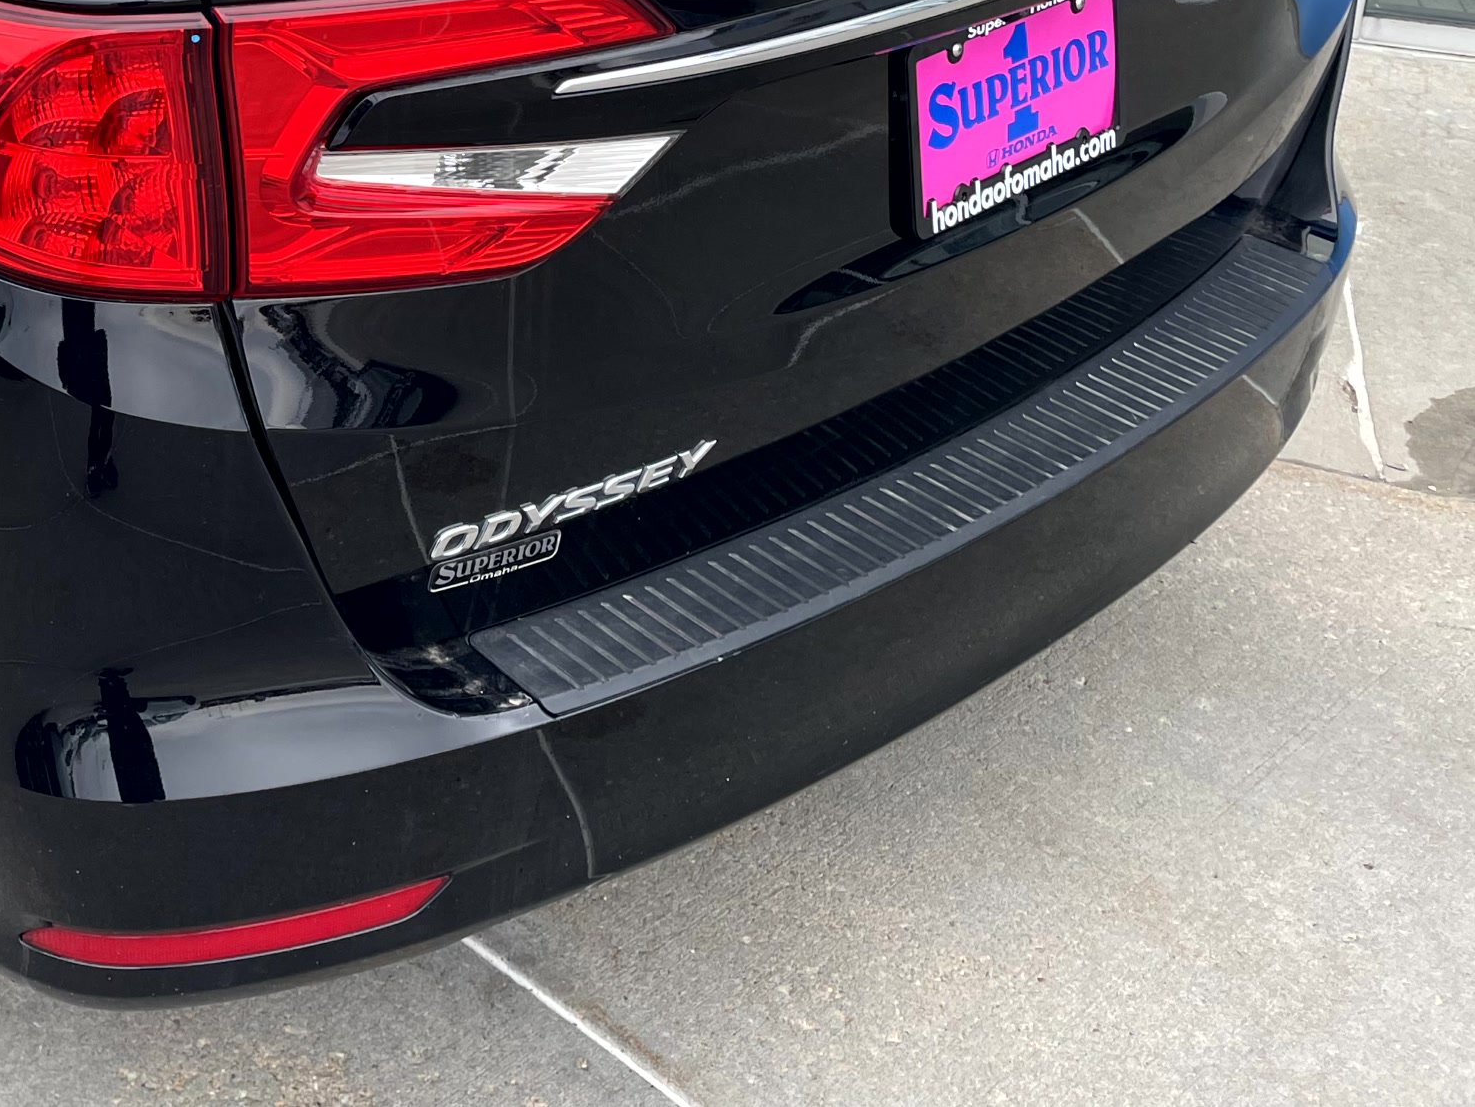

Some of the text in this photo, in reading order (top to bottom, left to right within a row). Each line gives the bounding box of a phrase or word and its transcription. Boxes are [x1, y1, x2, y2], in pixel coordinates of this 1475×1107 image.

[1001, 125, 1058, 160] HONDA
[931, 128, 1117, 234] hondaofomaha.com
[430, 439, 717, 562] ODYSSEY
[469, 565, 518, 584] Omaha
